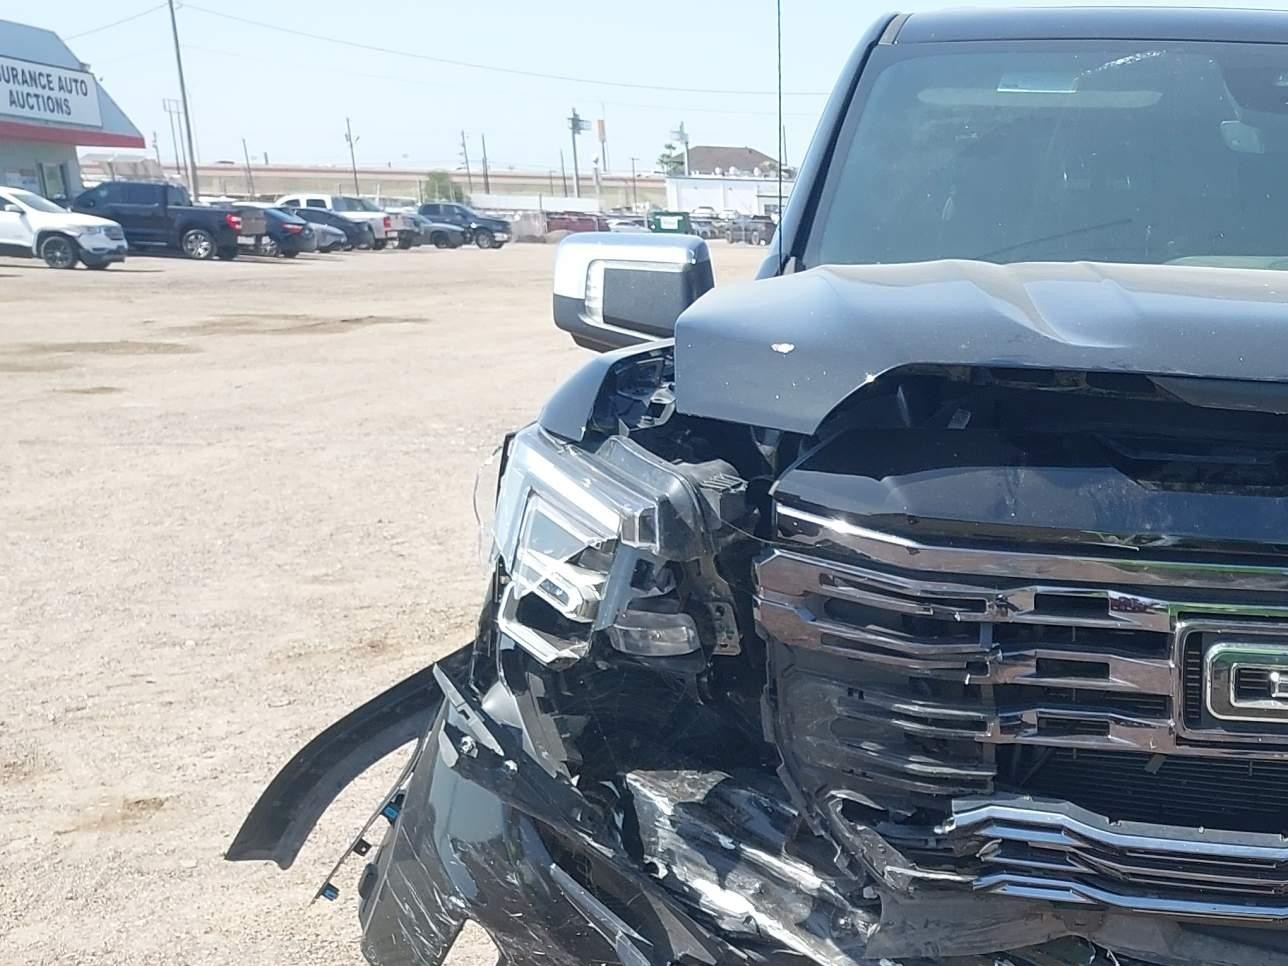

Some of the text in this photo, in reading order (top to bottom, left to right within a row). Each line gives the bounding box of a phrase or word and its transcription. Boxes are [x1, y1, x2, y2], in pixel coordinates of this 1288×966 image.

[0, 64, 88, 97] URANCE AUTO
[8, 89, 72, 116] AUCTIONS
